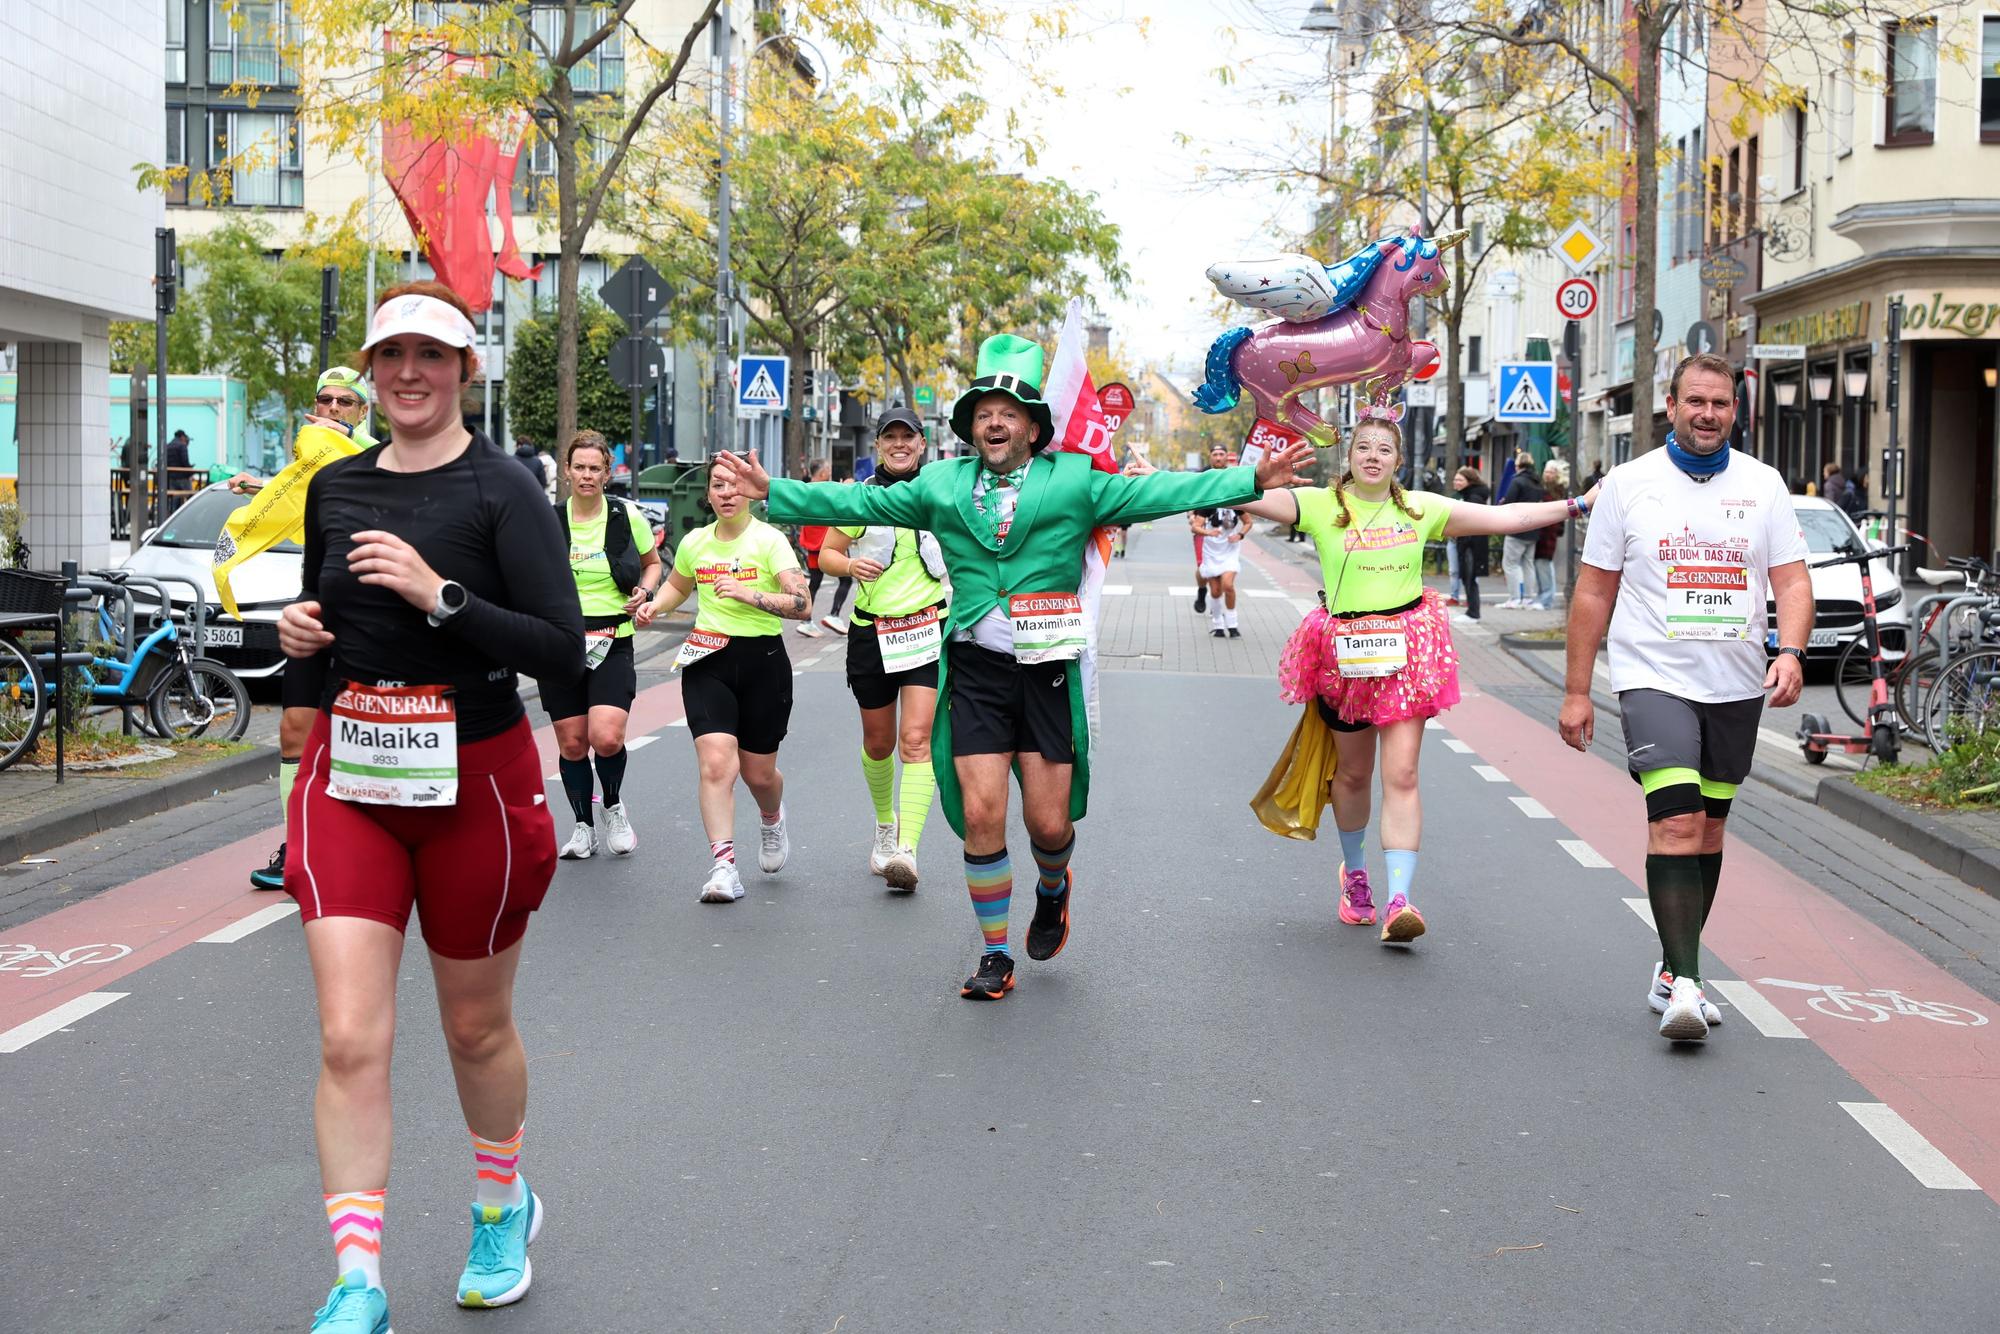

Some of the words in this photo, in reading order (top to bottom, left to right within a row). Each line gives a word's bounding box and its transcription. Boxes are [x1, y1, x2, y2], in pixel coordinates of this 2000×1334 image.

[1564, 290, 1588, 308] 30
[1251, 427, 1288, 452] 5:30
[1659, 549, 1677, 561] DER
[1705, 549, 1724, 562] DAS
[1726, 550, 1746, 563] ZIEL.
[1688, 571, 1745, 585] GENERALI
[1030, 595, 1080, 611] GENERALI
[1686, 590, 1732, 606] Frank
[891, 611, 936, 629] GENERALI
[1016, 618, 1081, 632] Maximilian
[1351, 619, 1401, 631] GENERALI
[211, 629, 241, 643] 5861
[885, 627, 934, 646] Melanie
[1344, 636, 1397, 649] Tamara
[354, 692, 450, 715] GENERALI
[341, 720, 440, 750] Malaika
[372, 754, 399, 766] 9933
[351, 786, 391, 800] MARATHON
[412, 792, 438, 801] PUMA
